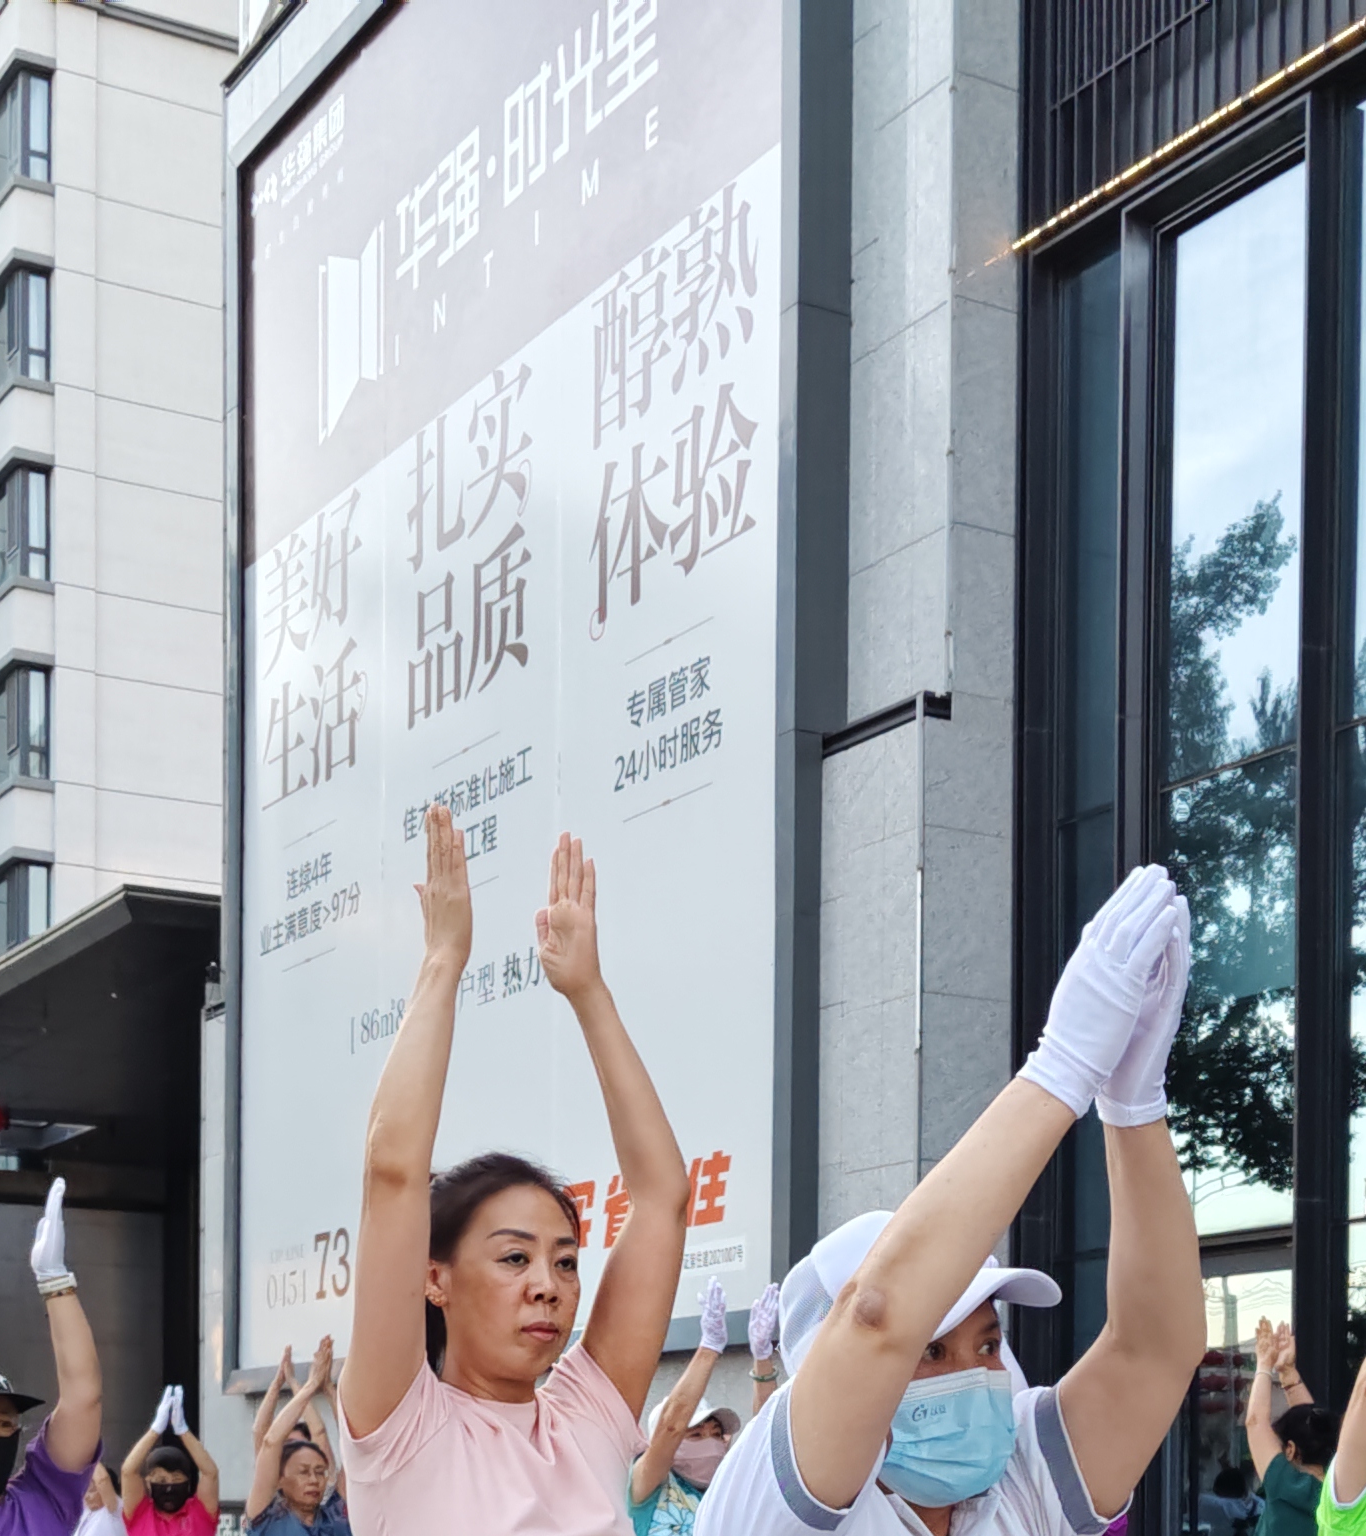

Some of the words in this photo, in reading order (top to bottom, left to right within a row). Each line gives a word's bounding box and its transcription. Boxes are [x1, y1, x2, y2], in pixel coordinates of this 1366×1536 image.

[592, 182, 758, 451] 醇熟
[407, 363, 533, 574] 扎实
[590, 384, 758, 624] 体验
[263, 487, 363, 681] 美好
[407, 521, 532, 730] 品质
[262, 637, 359, 811] 生活
[613, 708, 723, 793] 24小时服务
[626, 655, 711, 728] 专属管家
[286, 852, 332, 901] 连续4年
